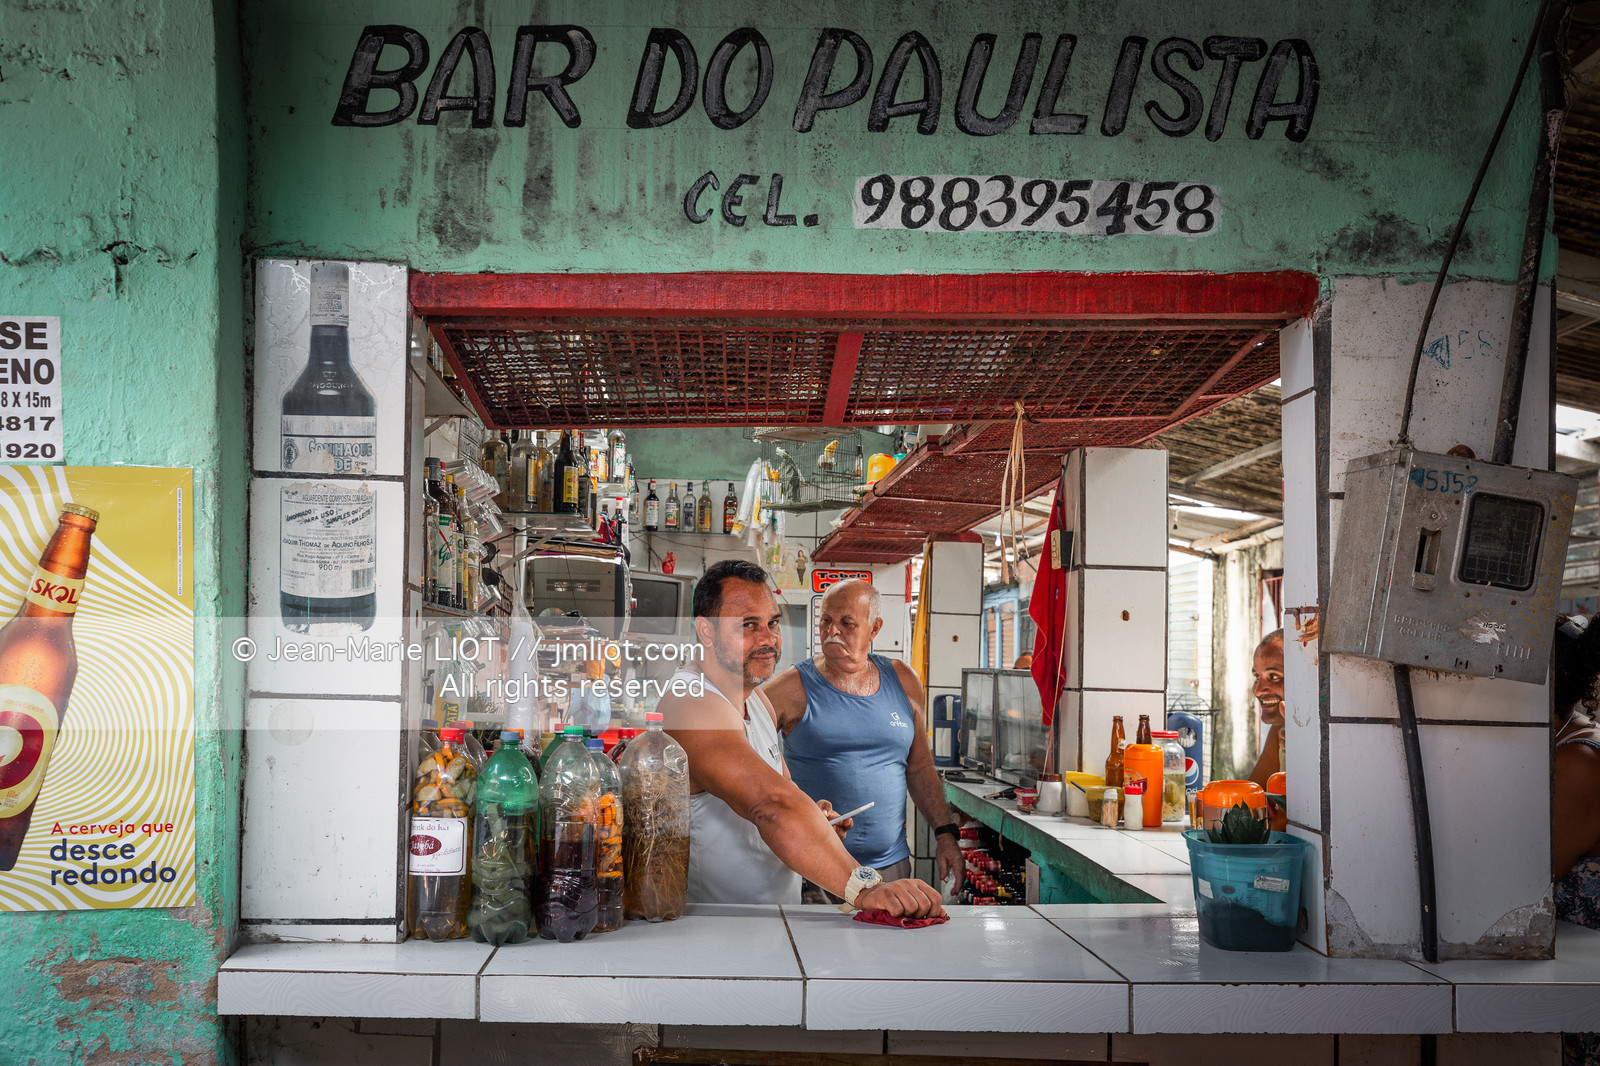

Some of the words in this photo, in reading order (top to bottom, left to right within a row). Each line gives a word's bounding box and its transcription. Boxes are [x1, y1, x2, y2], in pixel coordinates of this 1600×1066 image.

[331, 25, 597, 128] BAR
[626, 27, 774, 129] DO
[792, 28, 1320, 142] PAULISTA
[683, 171, 819, 227] CEL.
[861, 174, 1215, 235] 988395458
[0, 321, 48, 350] SE
[12, 391, 21, 408] X
[25, 391, 51, 408] 15m
[0, 443, 56, 459] 920
[320, 509, 335, 519] USO
[299, 539, 321, 548] THOMAZ
[31, 578, 79, 605] SKOL
[51, 822, 64, 835] A
[69, 820, 135, 838] cerveja
[141, 823, 174, 837] que
[50, 838, 136, 861] desce
[51, 861, 177, 886] redondo
